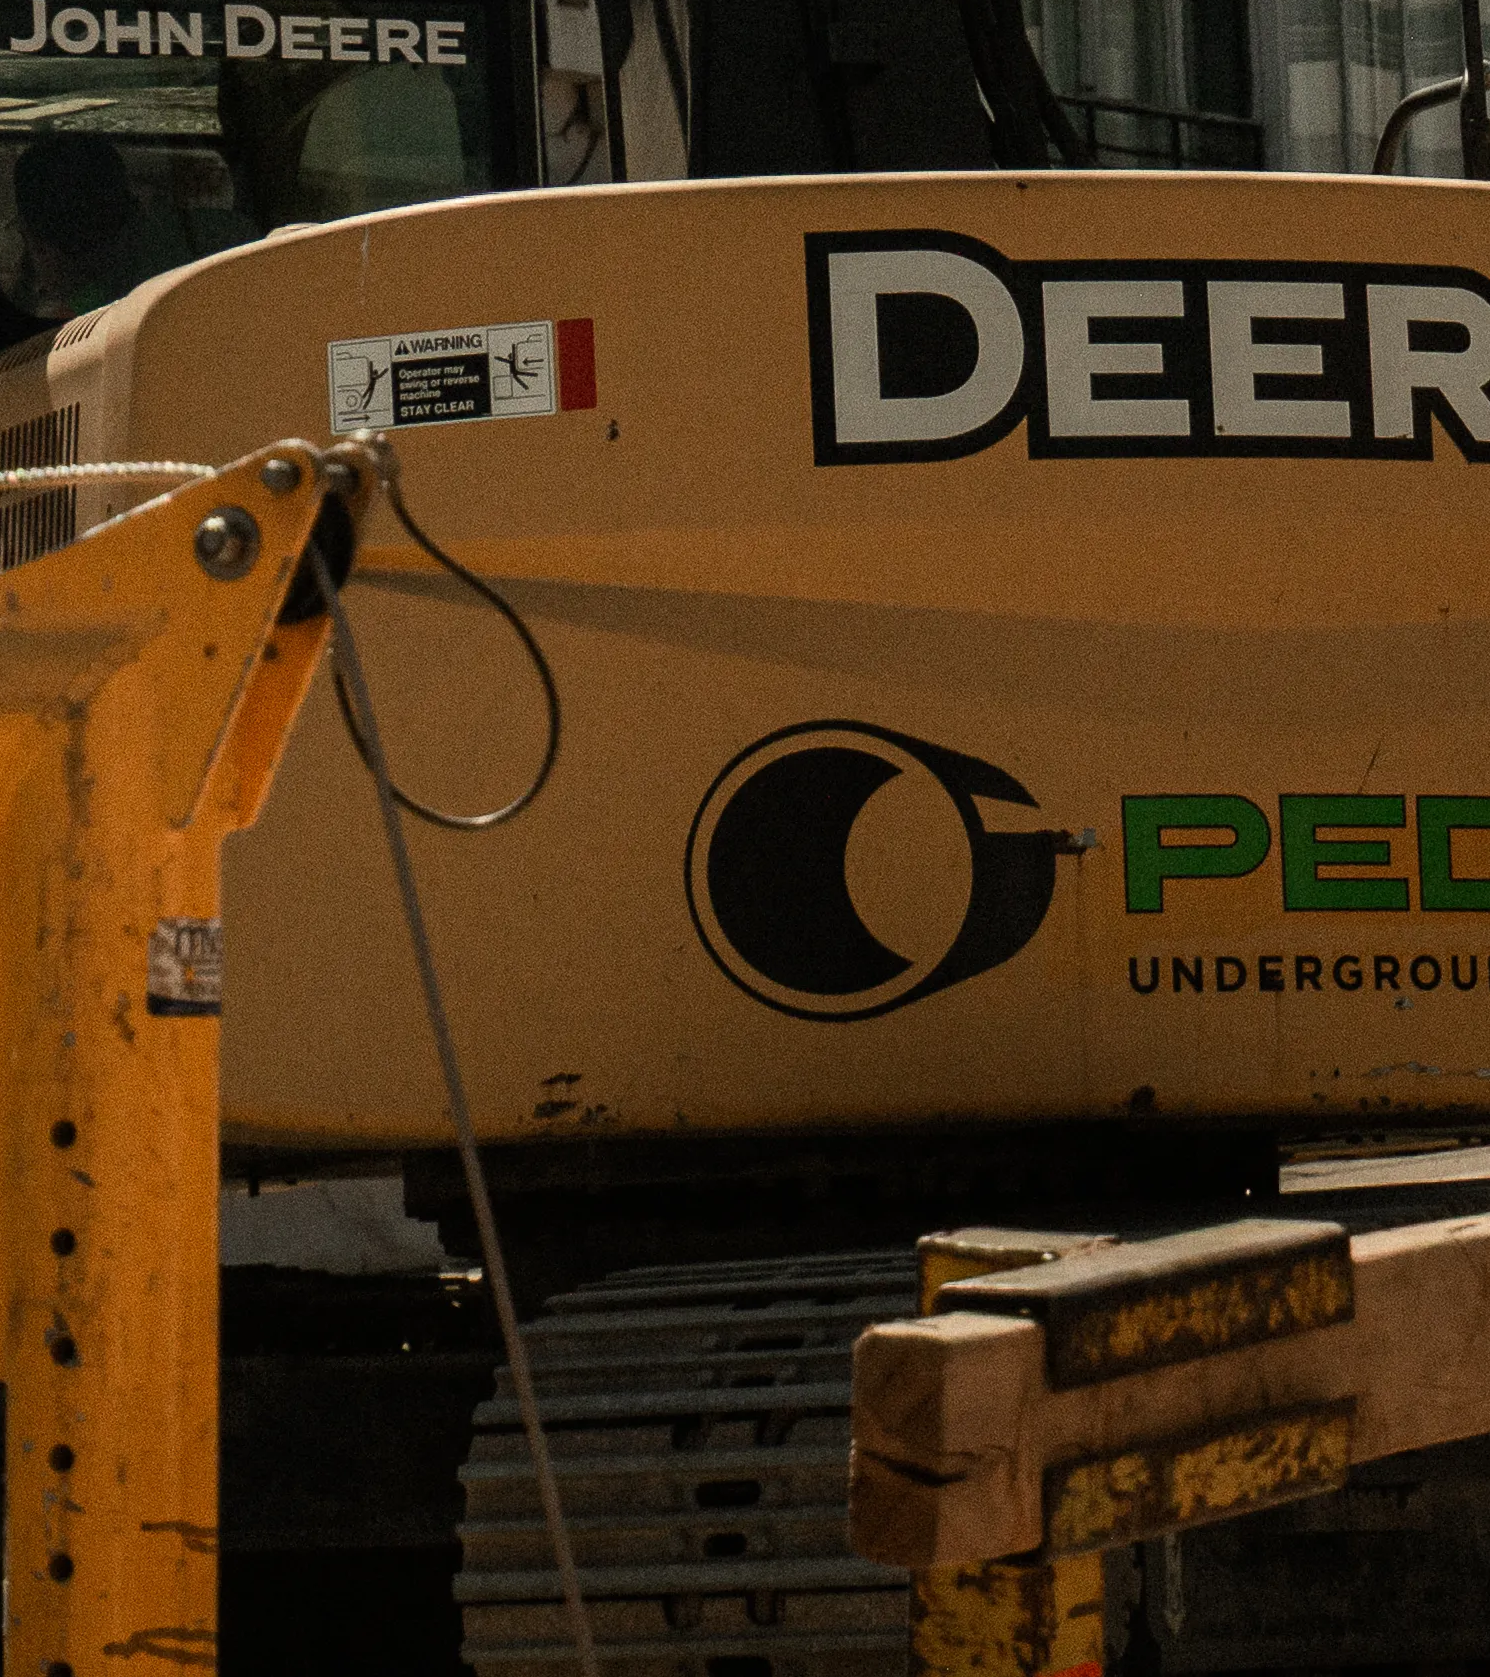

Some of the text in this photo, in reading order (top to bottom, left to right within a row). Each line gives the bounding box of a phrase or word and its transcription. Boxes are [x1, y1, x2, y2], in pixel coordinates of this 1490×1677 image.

[223, 3, 467, 65] DEERE
[410, 333, 483, 354] WARNING
[398, 365, 466, 380] Operator may
[429, 379, 441, 388] or
[443, 375, 481, 387] reverse
[399, 389, 442, 402] machine
[399, 399, 476, 419] STAY CLEAR
